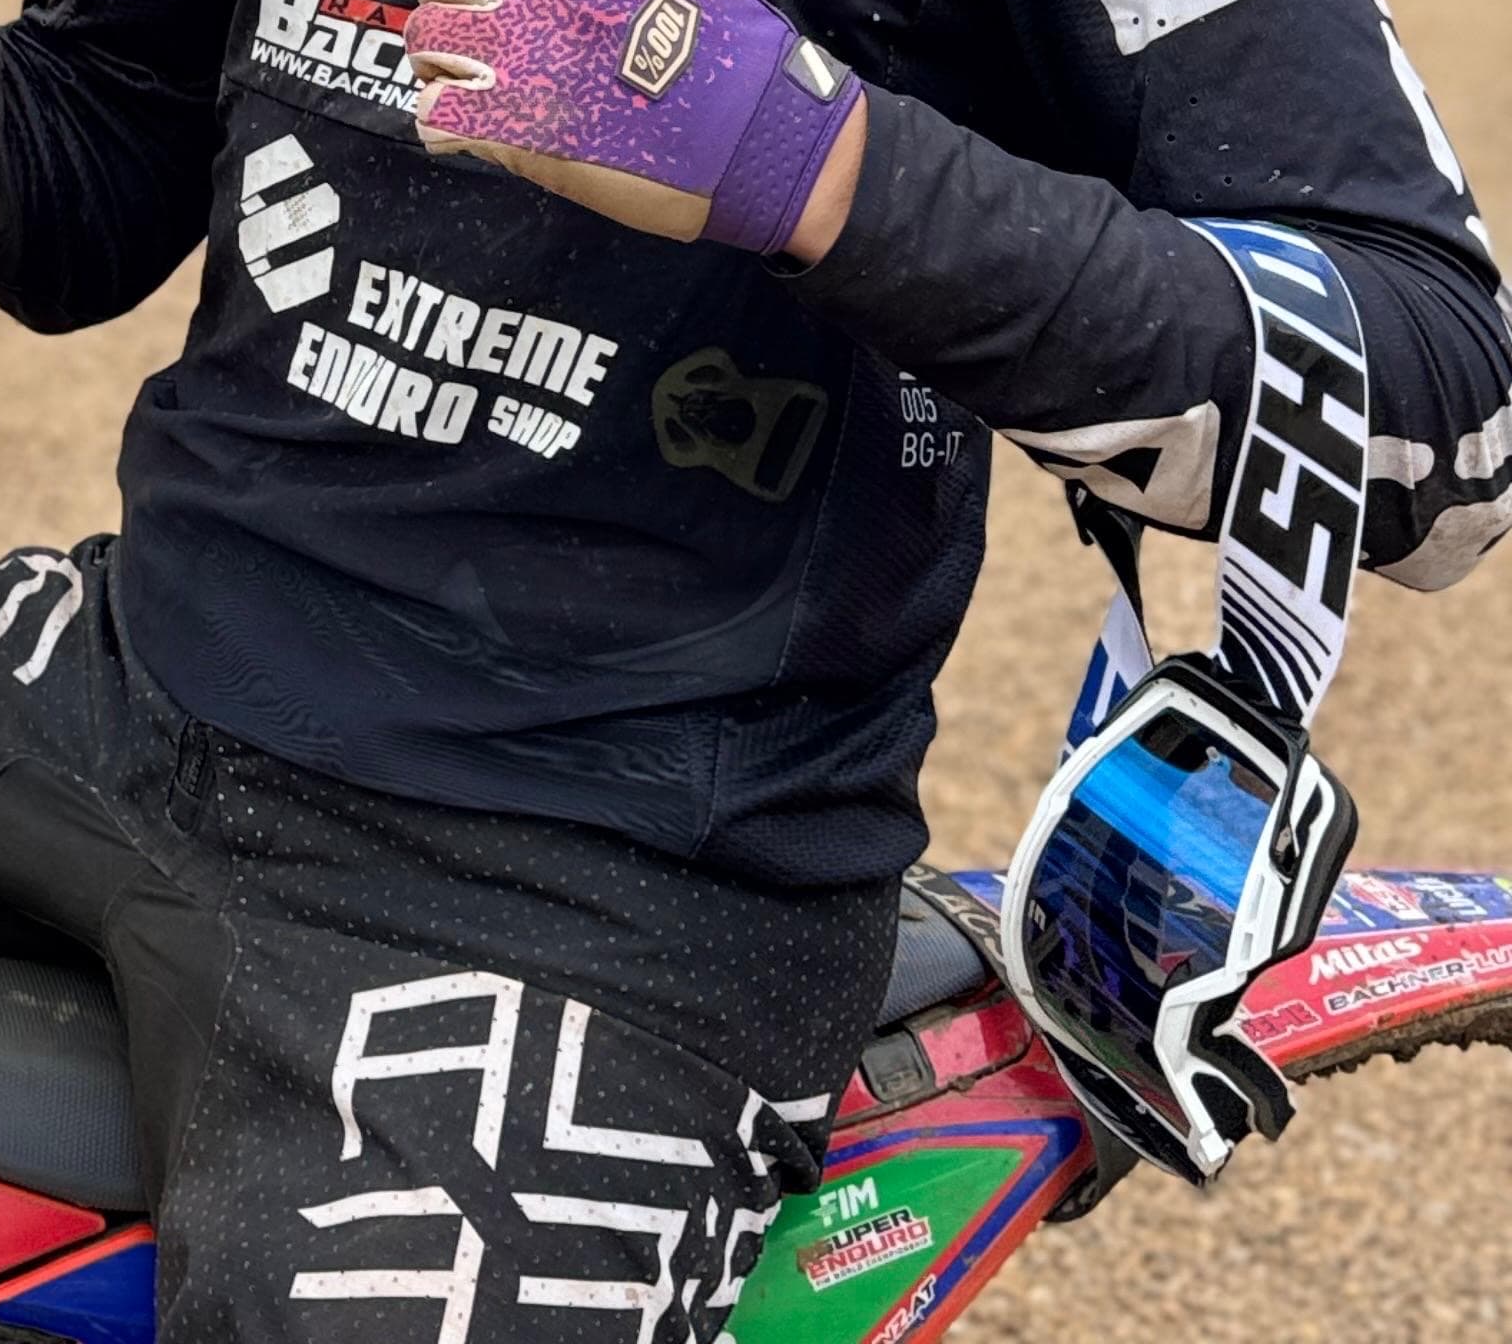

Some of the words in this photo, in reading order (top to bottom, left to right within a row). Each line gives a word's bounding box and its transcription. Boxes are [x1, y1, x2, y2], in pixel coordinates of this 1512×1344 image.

[634, 2, 684, 80] 100%
[347, 259, 619, 407] EXTREME
[287, 321, 479, 445] ENDURO
[488, 395, 582, 459] SHOP
[900, 386, 938, 423] 005
[900, 431, 965, 468] BG-IT
[1309, 936, 1422, 985] Mitas
[1327, 947, 1512, 1012] BACHNER-LU
[810, 1176, 879, 1227] FIM
[808, 1220, 929, 1280] ENDURO
